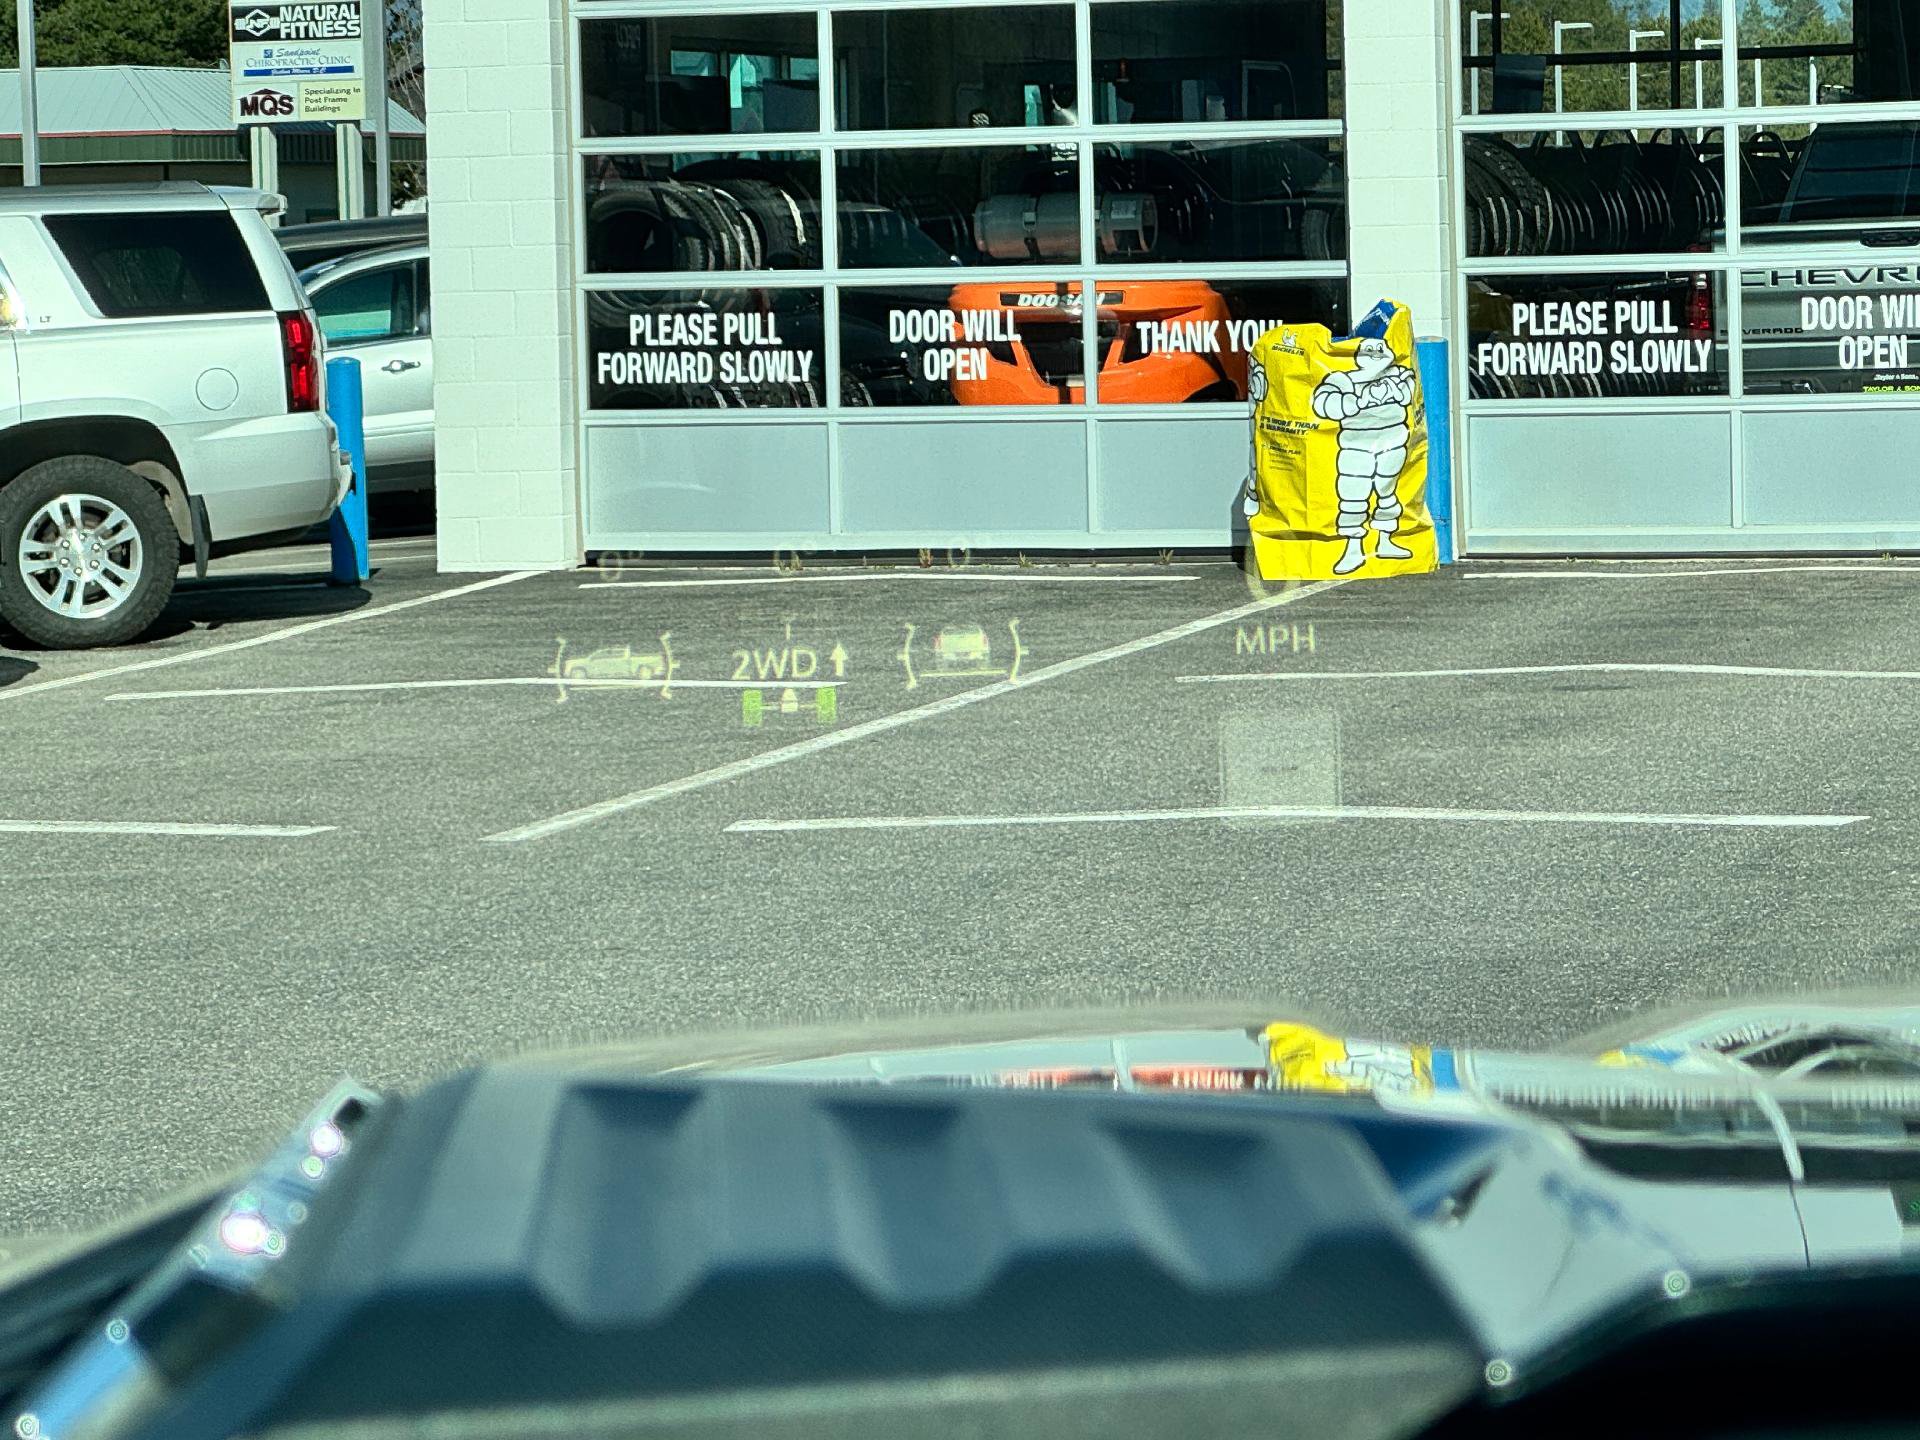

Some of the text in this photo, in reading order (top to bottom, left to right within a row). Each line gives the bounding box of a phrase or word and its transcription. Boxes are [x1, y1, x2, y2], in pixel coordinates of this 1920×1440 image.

[280, 4, 359, 22] NATURAL
[280, 20, 360, 38] FITNESS
[276, 48, 320, 58] Sandpoint
[318, 55, 351, 65] CLINIC
[305, 87, 351, 95] Specializing
[240, 94, 294, 116] MQS
[305, 105, 341, 113] Buildings
[1741, 267, 1920, 287] CHEVR
[1512, 300, 1678, 336] PLEASE PULL
[1801, 296, 1873, 331] DOOR
[629, 312, 783, 346] PLEASE PULL
[889, 309, 1022, 343] DOOR WILL
[1136, 319, 1284, 354] THANK YO
[1720, 327, 1804, 335] SVERADO
[1272, 345, 1304, 356] MICHELIN
[1478, 339, 1711, 376] FORWARD SLOWLY
[1838, 335, 1908, 369] OPEN
[597, 350, 814, 384] FORWARD SLOWLY
[923, 347, 988, 382] OPEN
[1862, 385, 1894, 393] TAYLOR
[1272, 417, 1292, 427] MORE
[1294, 421, 1320, 430] THAN
[1235, 623, 1317, 655] MPH
[731, 649, 817, 681] 2WD
